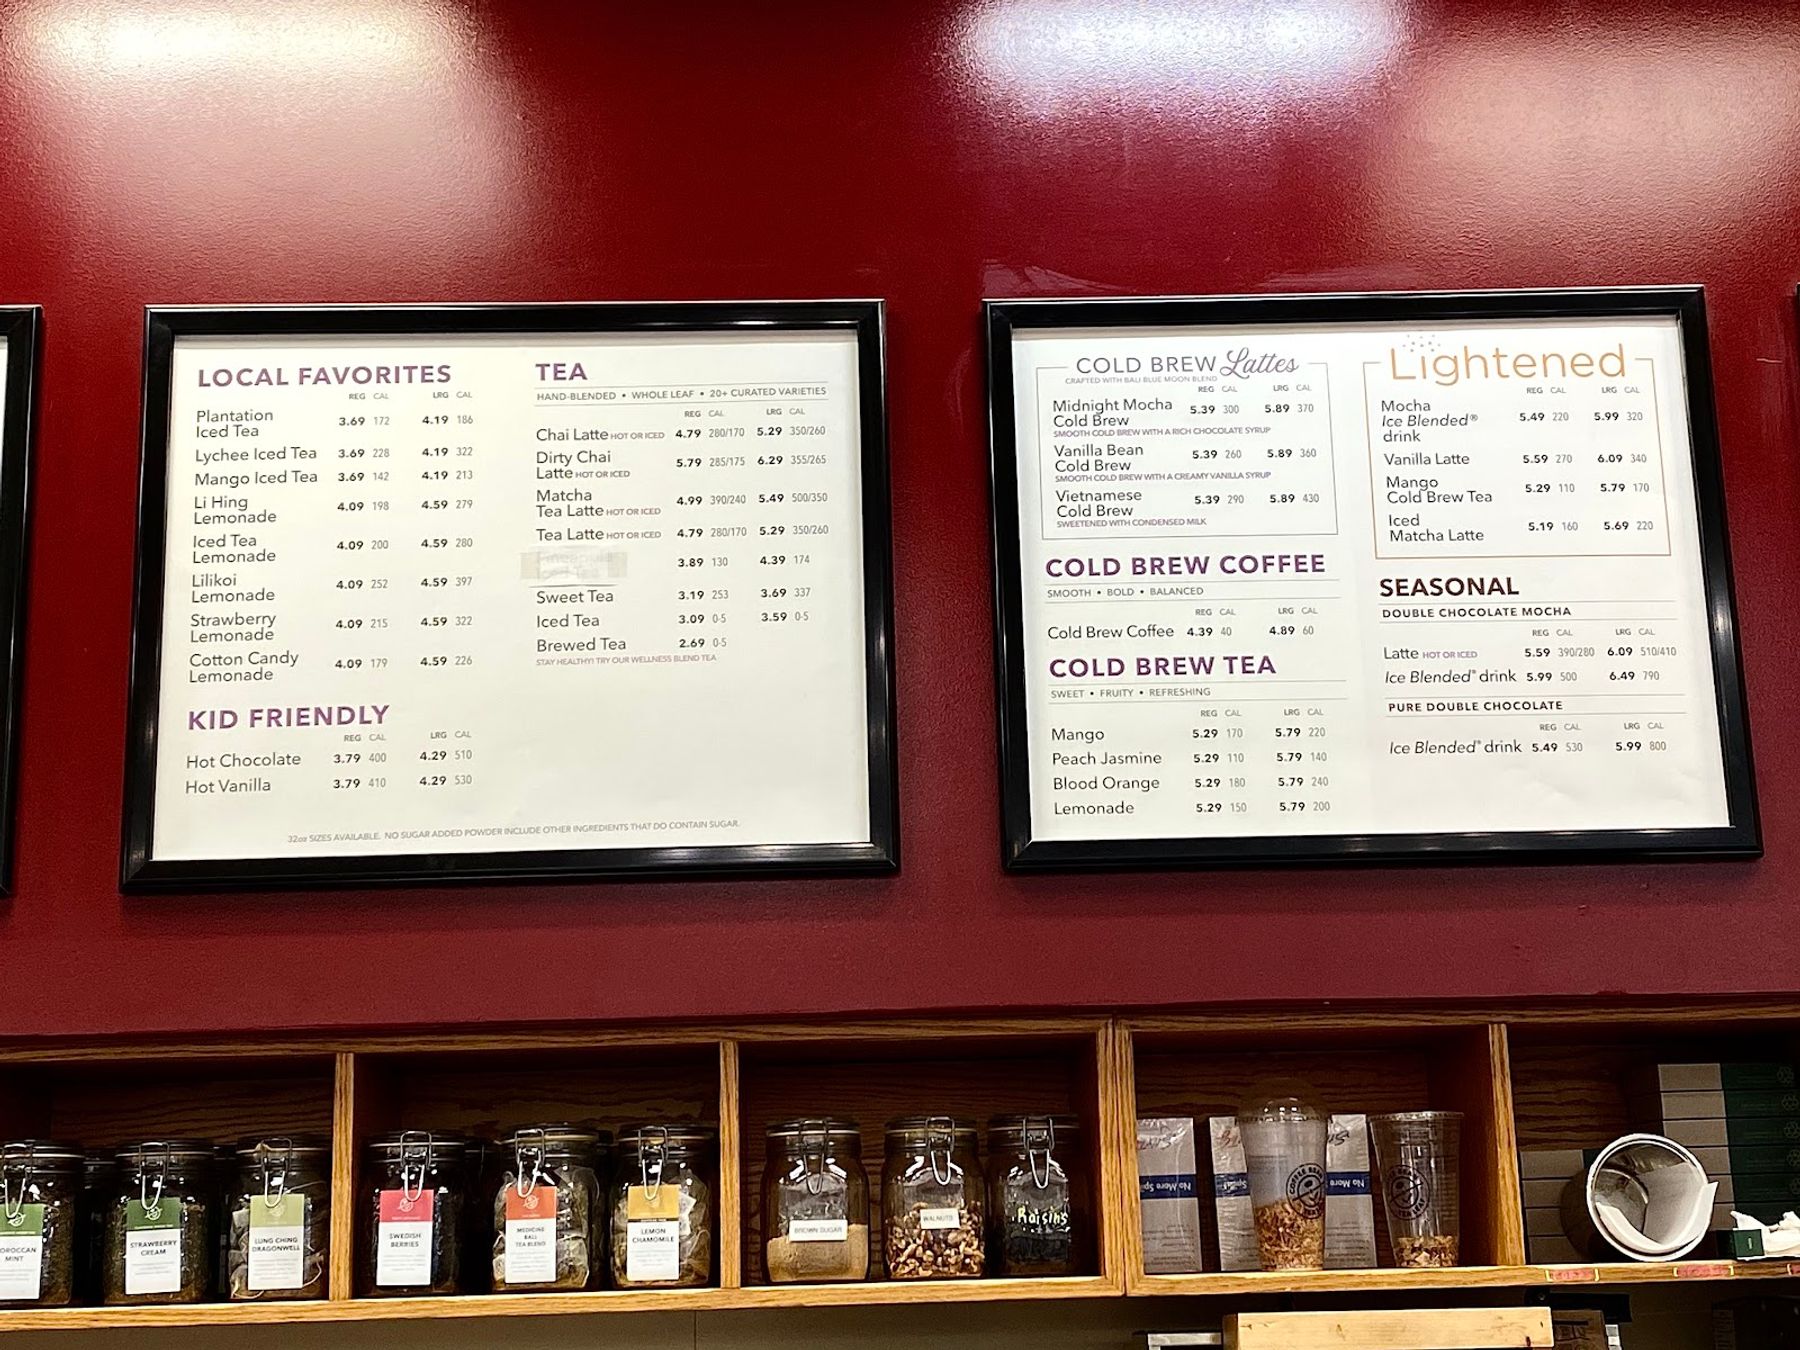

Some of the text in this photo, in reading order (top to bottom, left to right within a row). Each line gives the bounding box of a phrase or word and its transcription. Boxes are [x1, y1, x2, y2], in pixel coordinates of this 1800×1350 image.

[1077, 348, 1299, 379] COLD BREW Lattes
[1391, 343, 1625, 386] Lightened
[199, 365, 450, 387] LOCAL FAVORITES
[536, 363, 587, 380] TEA
[537, 387, 826, 400] HAND-BLENDED WHOLE LEAF 20+ CURATED VARIETIES
[1053, 398, 1172, 415] Midnight Mocha
[1191, 404, 1314, 414] 5.39 300 5.89 370
[1382, 399, 1430, 412] Mocha
[197, 410, 273, 422] Plantation
[339, 415, 473, 426] 3.69 172 4.19 186
[1054, 414, 1129, 427] Cold Brew
[1382, 414, 1478, 427] Ice Blended®
[1520, 412, 1643, 421] 5.49 220 5.99 320
[197, 424, 258, 438] Iced Tea
[537, 428, 608, 441] Chai Latte
[675, 426, 825, 438] 4.79 280/170 5.29 350/260
[1383, 429, 1420, 442] drink
[196, 446, 316, 465] Lychee Iced Tea
[1384, 452, 1469, 465] Vanilla Latte
[1387, 476, 1438, 491] Mango
[537, 488, 592, 501] Matcha
[1056, 490, 1142, 502] Vietnamese
[1387, 491, 1492, 503] Cold Brew Tea
[195, 496, 248, 511] Li Hing
[337, 500, 473, 511] 4.09 198 4.59 279
[194, 509, 276, 524] Lemonade
[536, 505, 604, 517] Tea Latte
[1057, 504, 1133, 517] Cold Brew
[1057, 520, 1108, 528] SWEETENED
[1046, 555, 1325, 577] COLD BREW COFFEE
[679, 587, 811, 600] 3.19 253 3.69 337
[1048, 587, 1204, 598] SMOOTH BOLD BALANCED
[1380, 577, 1519, 597] SEASONAL
[537, 590, 613, 604] Sweet Tea
[1383, 607, 1571, 618] DOUBLE CHOCOLATE MOCHA
[191, 612, 276, 628] Strawberry
[191, 627, 274, 642] Lemonade
[1048, 624, 1174, 639] Cold Brew Coffee
[537, 637, 626, 652] Brewed Tea
[680, 637, 726, 648] 2.69 0-5
[190, 650, 299, 667] Cotton Candy
[1050, 656, 1276, 677] COLD BREW TEA
[190, 667, 273, 683] Lemonade
[1389, 701, 1562, 712] PURE DOUBLE CHOCOLATE
[189, 705, 389, 730] KID FRIENDLY
[187, 752, 301, 768] Hot Chocolate
[334, 750, 472, 763] 3.79 400 4.29 510
[1053, 752, 1161, 765] Peach Jasmine
[1054, 776, 1159, 792] Blood Orange
[1195, 777, 1328, 787] 5.29 180 5.79 240
[1018, 1207, 1068, 1225] Raisins
